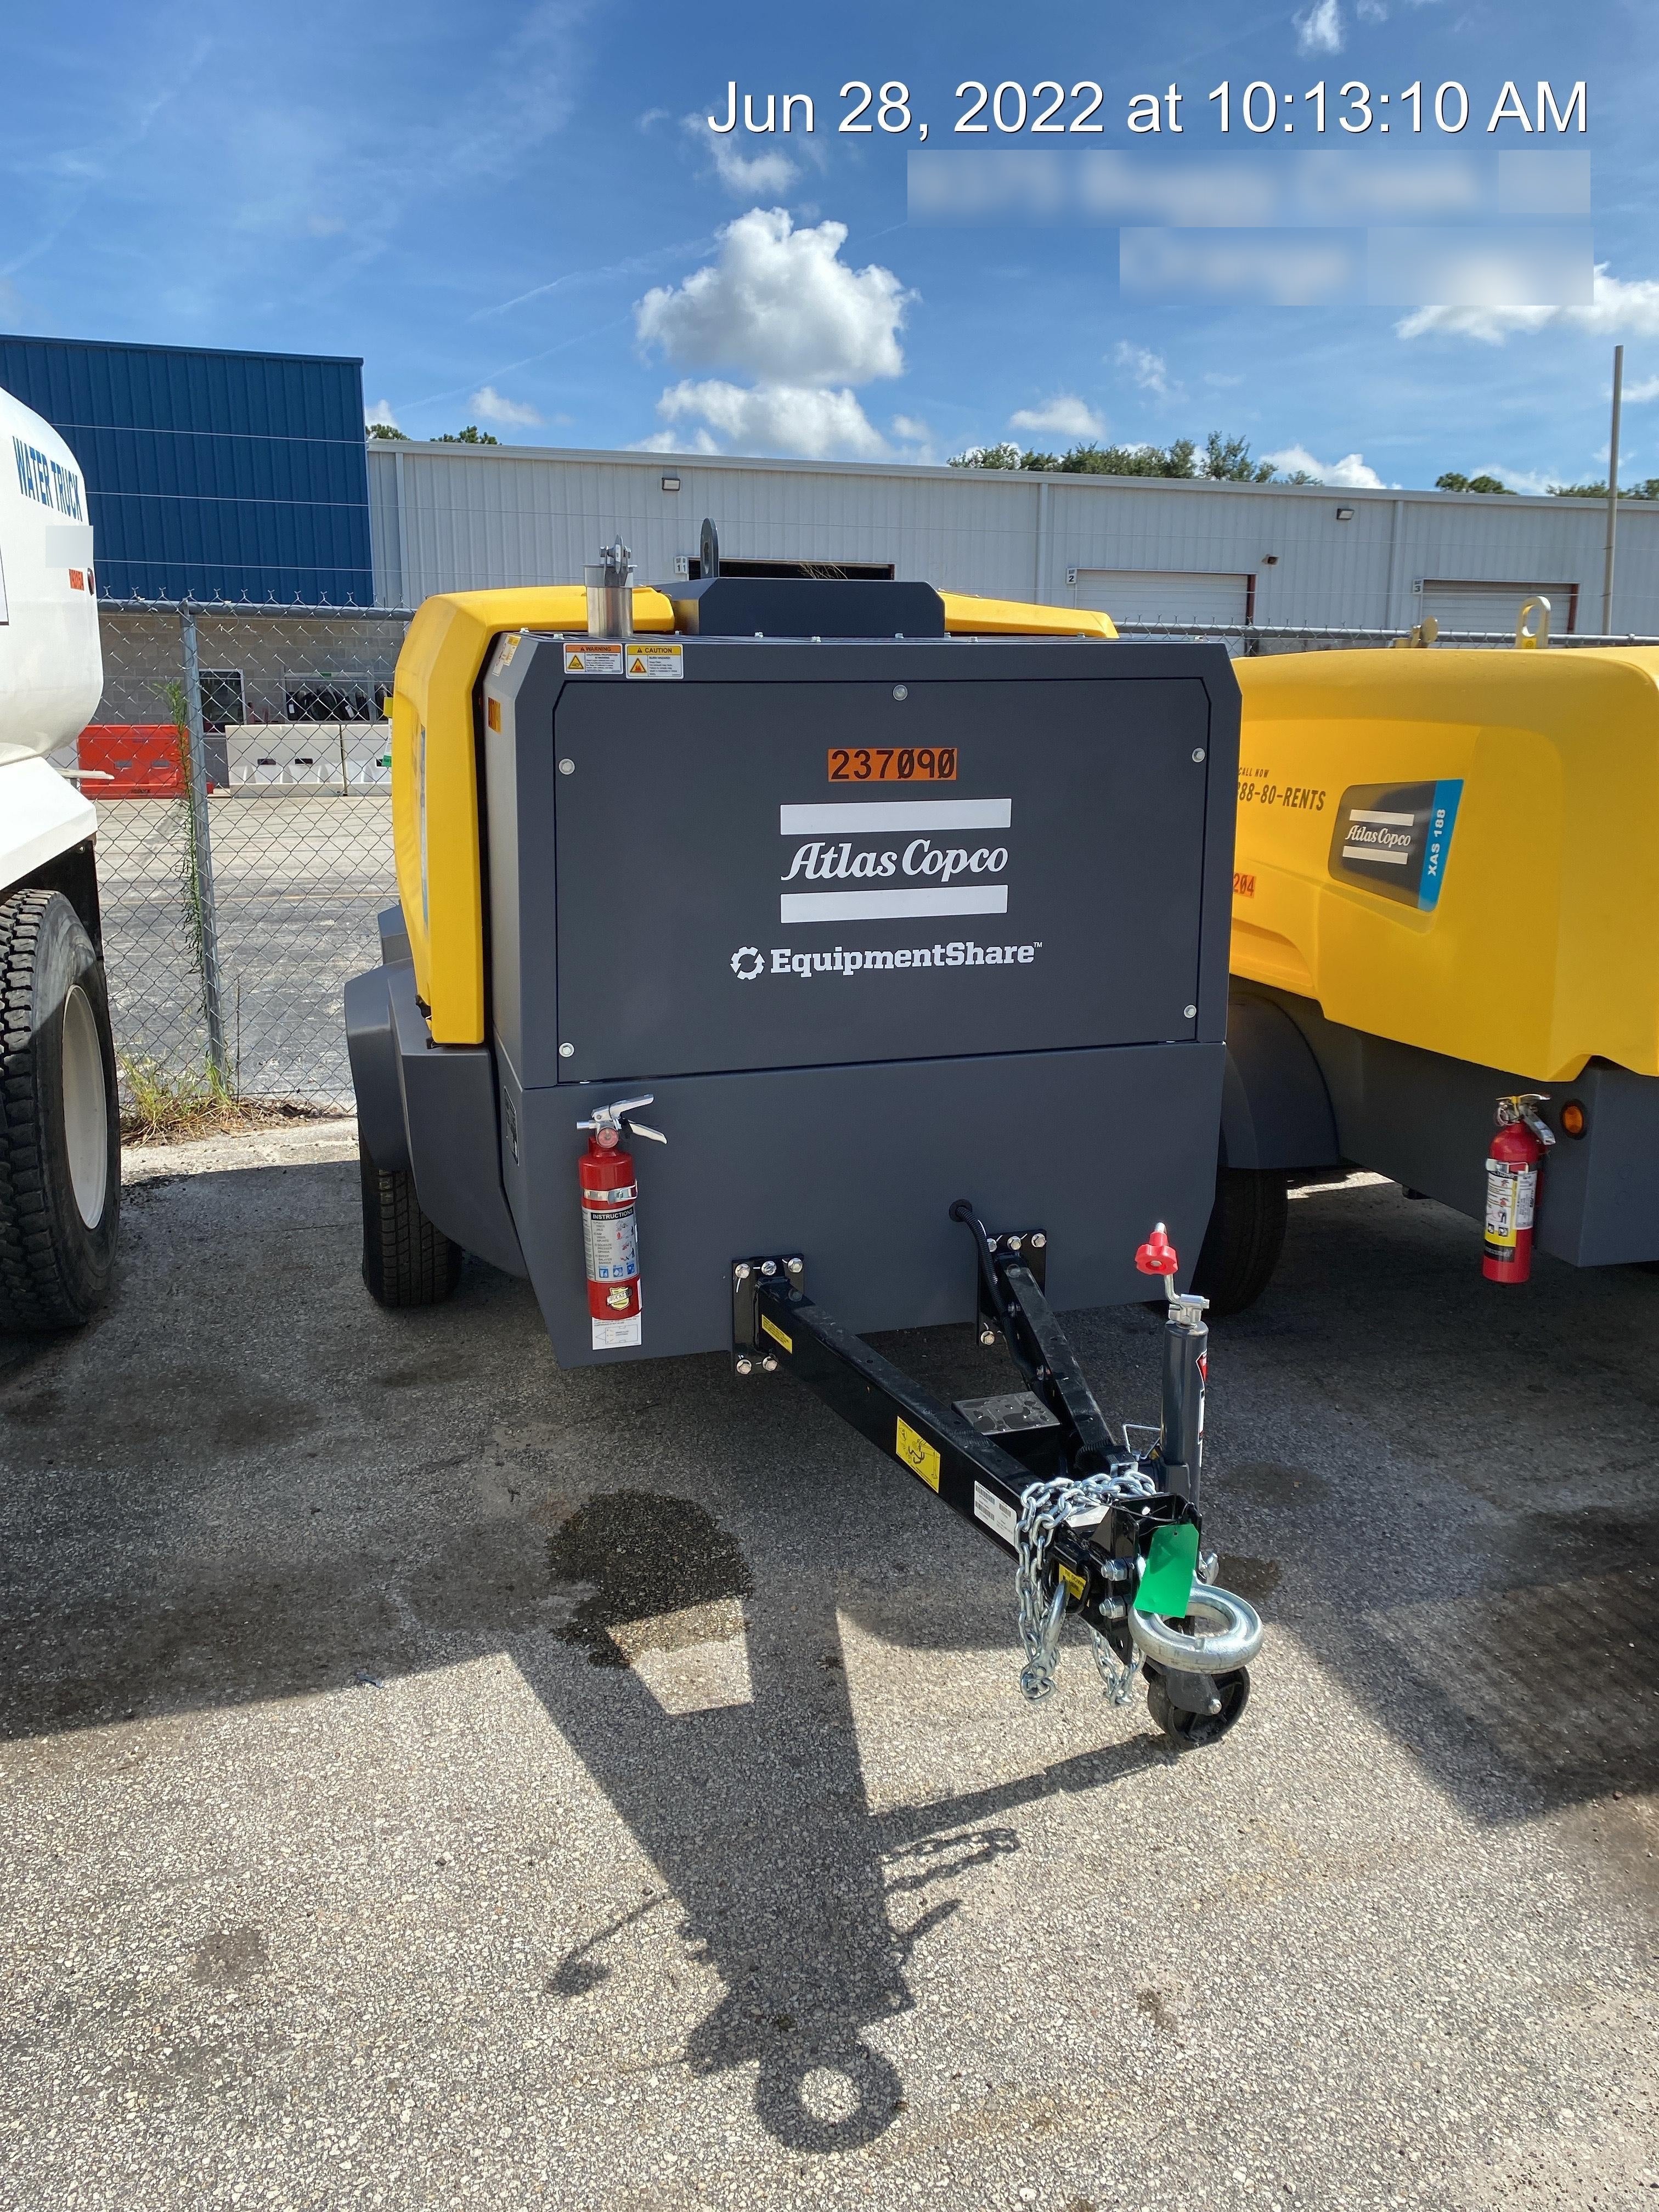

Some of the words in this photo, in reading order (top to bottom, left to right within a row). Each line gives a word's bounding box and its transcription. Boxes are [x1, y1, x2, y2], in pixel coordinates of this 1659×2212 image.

[12, 435, 54, 509] WATER
[50, 459, 83, 522] TRUCK
[830, 748, 956, 780] 237090
[1238, 767, 1253, 777] CALL
[1255, 768, 1269, 778] NOW
[1345, 825, 1378, 843] Atlas
[1378, 827, 1412, 848] Copco
[1434, 809, 1446, 838] 188
[780, 842, 898, 881] Atlas
[901, 838, 1009, 883] Copco
[1428, 843, 1441, 877] XAS
[592, 1208, 633, 1220] INSTRUCTIONS
